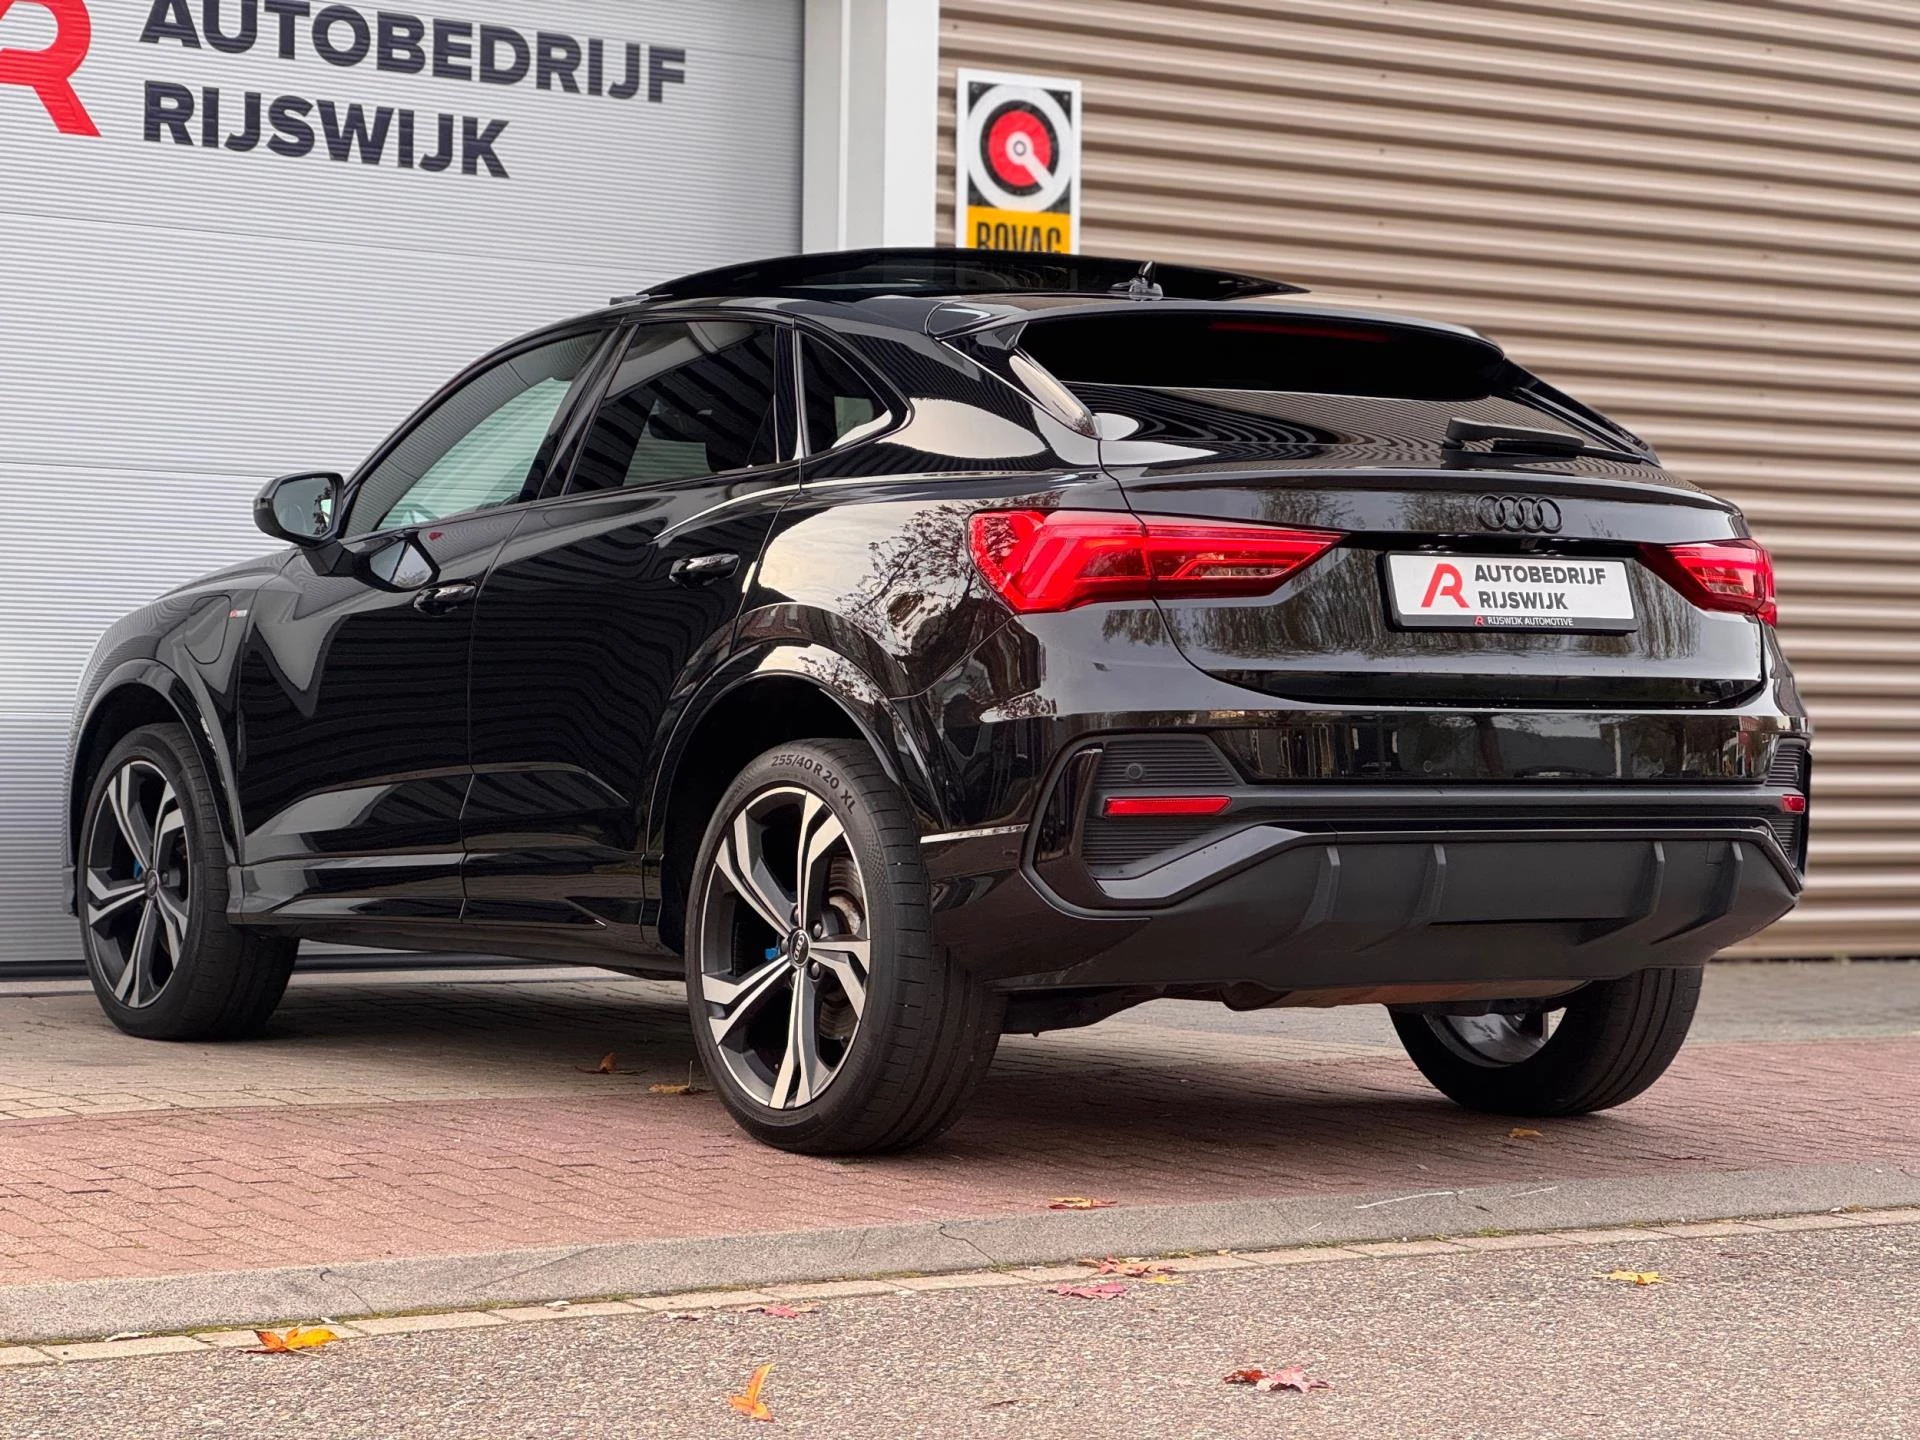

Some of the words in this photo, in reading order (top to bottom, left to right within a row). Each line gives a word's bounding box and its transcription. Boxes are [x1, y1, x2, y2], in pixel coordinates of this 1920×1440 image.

[139, 0, 686, 103] AUTOBEDRIJF
[143, 80, 510, 179] RIJSWIJK
[1475, 564, 1606, 585] AUTOBEDRIJF
[1478, 591, 1569, 610] RIJSWIJK
[1487, 616, 1523, 625] RIJSWIJK
[1524, 617, 1574, 626] AUTOMOTIVE
[771, 754, 813, 771] 255/40
[812, 764, 823, 776] R
[822, 770, 840, 789] 20
[840, 790, 856, 815] XL
